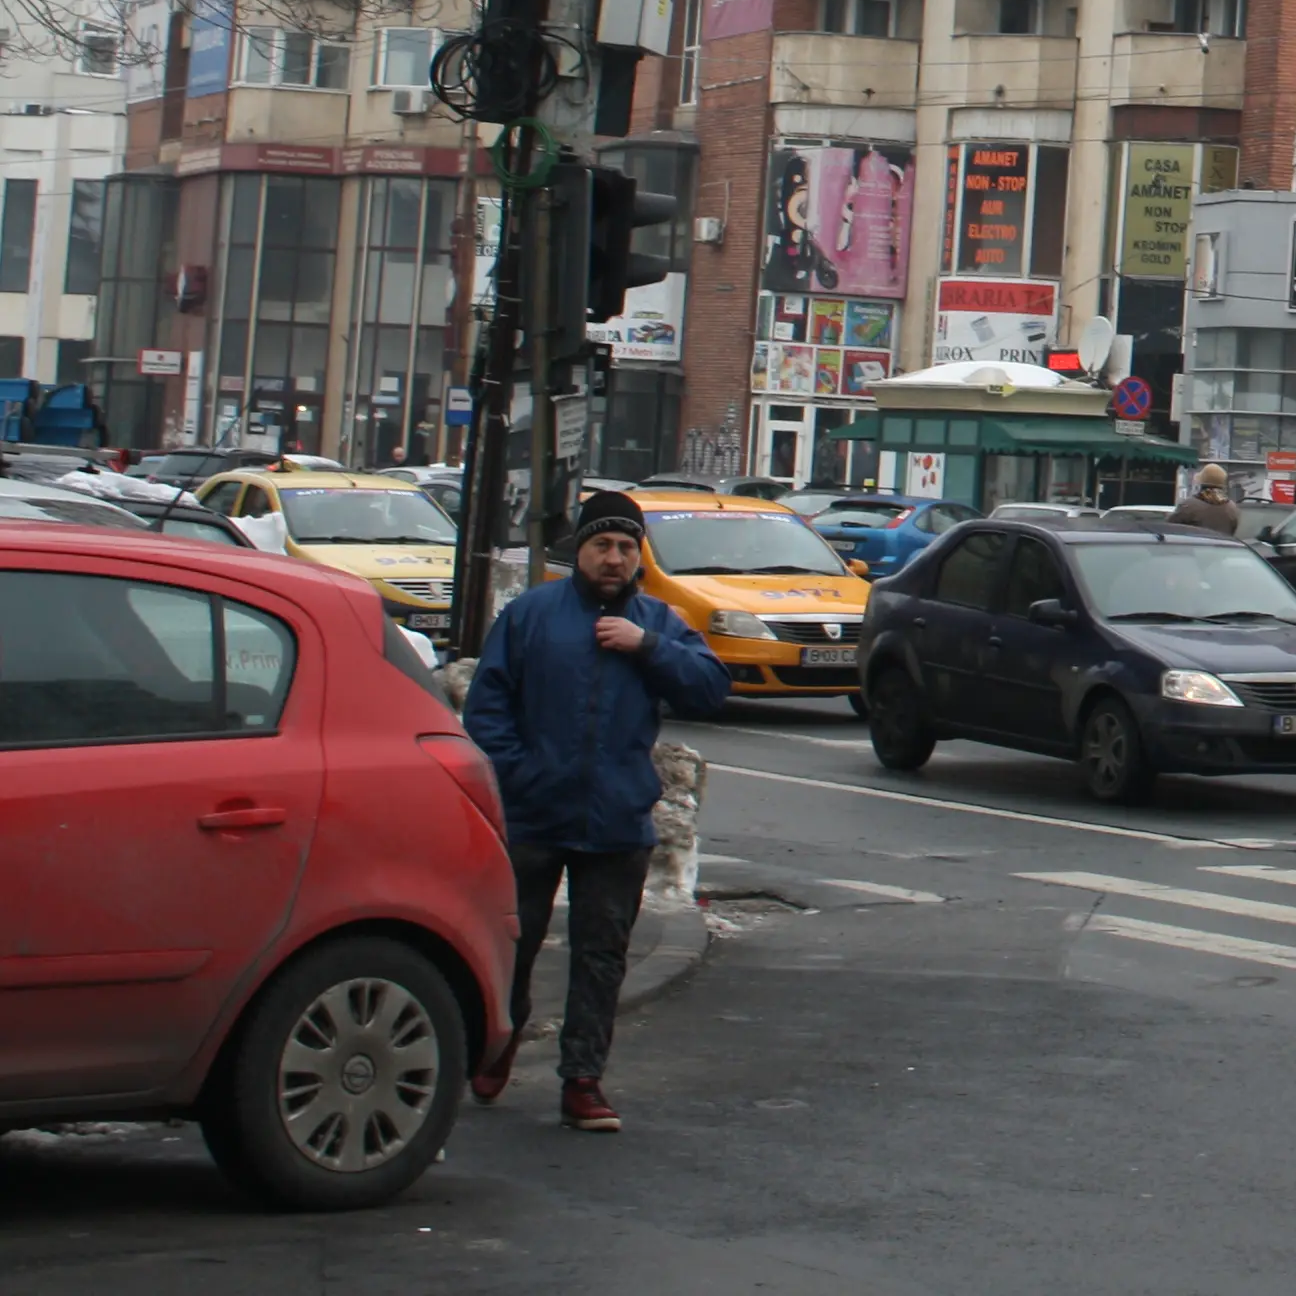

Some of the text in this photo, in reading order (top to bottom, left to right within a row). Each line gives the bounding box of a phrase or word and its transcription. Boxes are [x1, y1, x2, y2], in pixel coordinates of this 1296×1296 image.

[1144, 158, 1181, 173] CASA
[966, 174, 990, 190] NON
[997, 175, 1027, 192] STOP
[1130, 183, 1192, 200] AMANET
[1144, 206, 1172, 218] NON
[1155, 221, 1188, 234] STOP
[1141, 254, 1171, 266] GOLD
[760, 588, 842, 600] 9477
